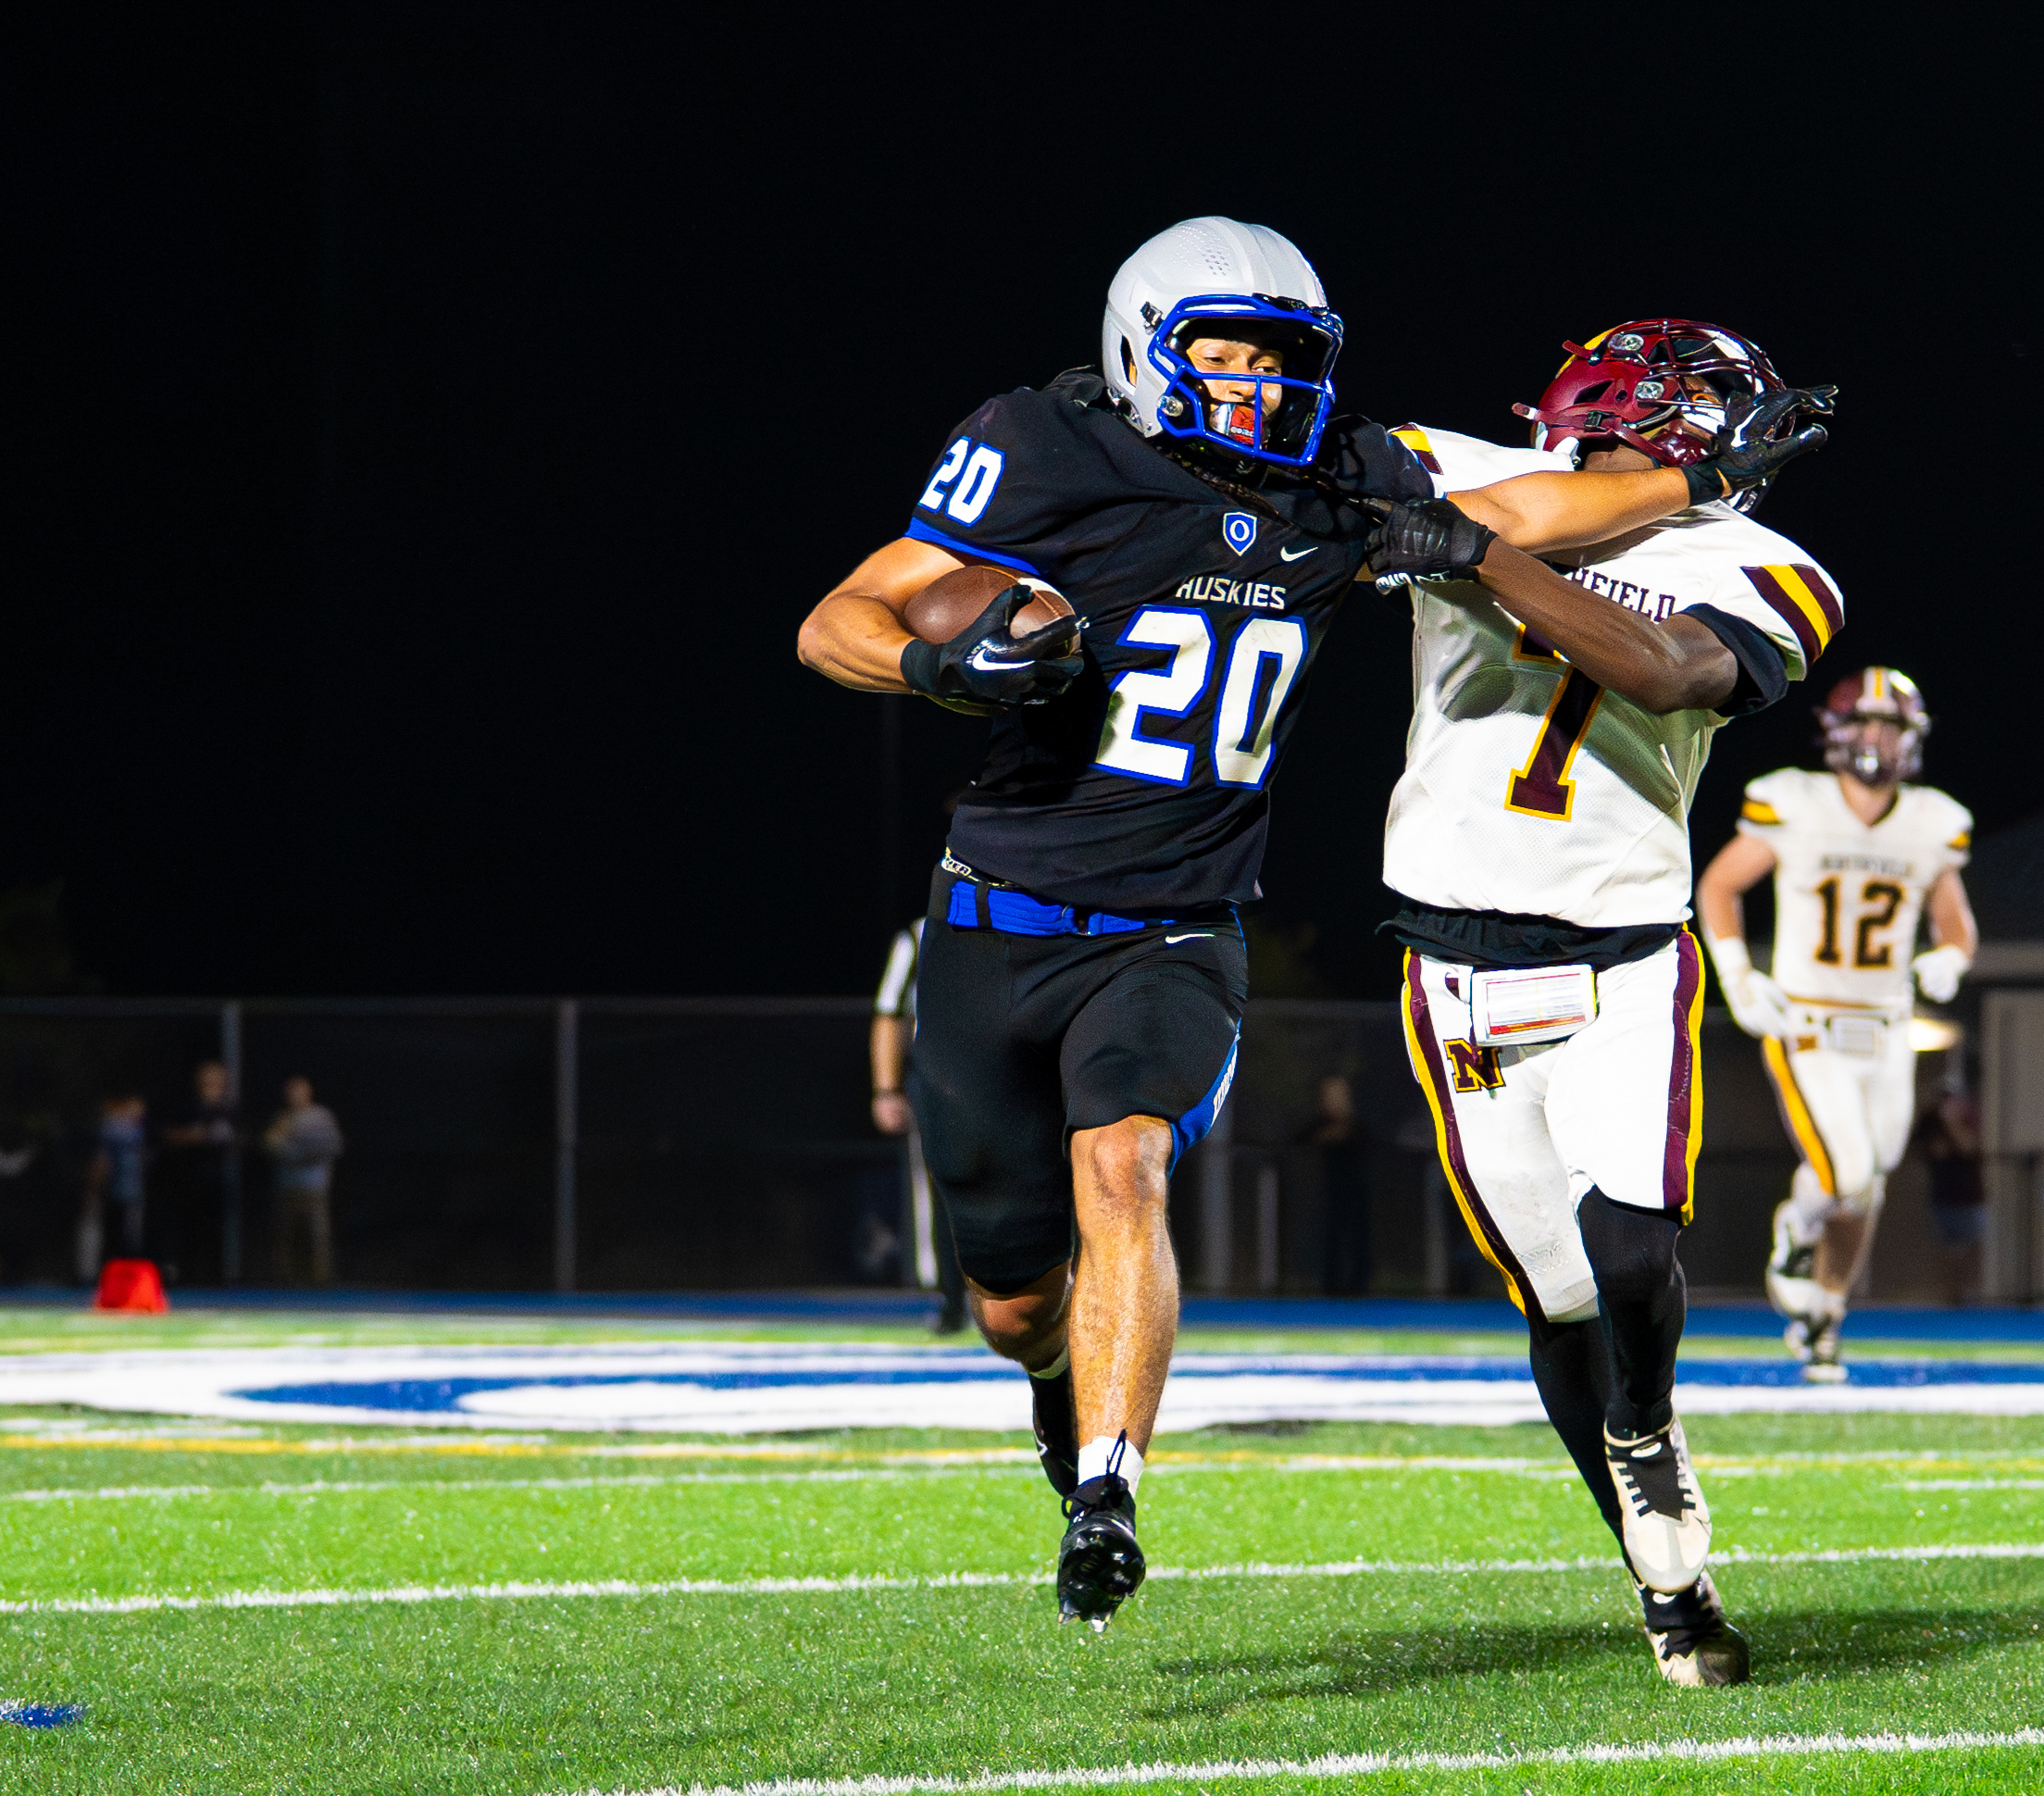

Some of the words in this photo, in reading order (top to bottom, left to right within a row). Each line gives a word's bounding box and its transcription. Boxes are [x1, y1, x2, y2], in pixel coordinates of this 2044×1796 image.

[917, 435, 1006, 527] 20
[1175, 576, 1287, 610] HUSKIES
[1089, 605, 1308, 791] 20
[1504, 622, 1605, 821] 7
[1813, 875, 1907, 970] 12
